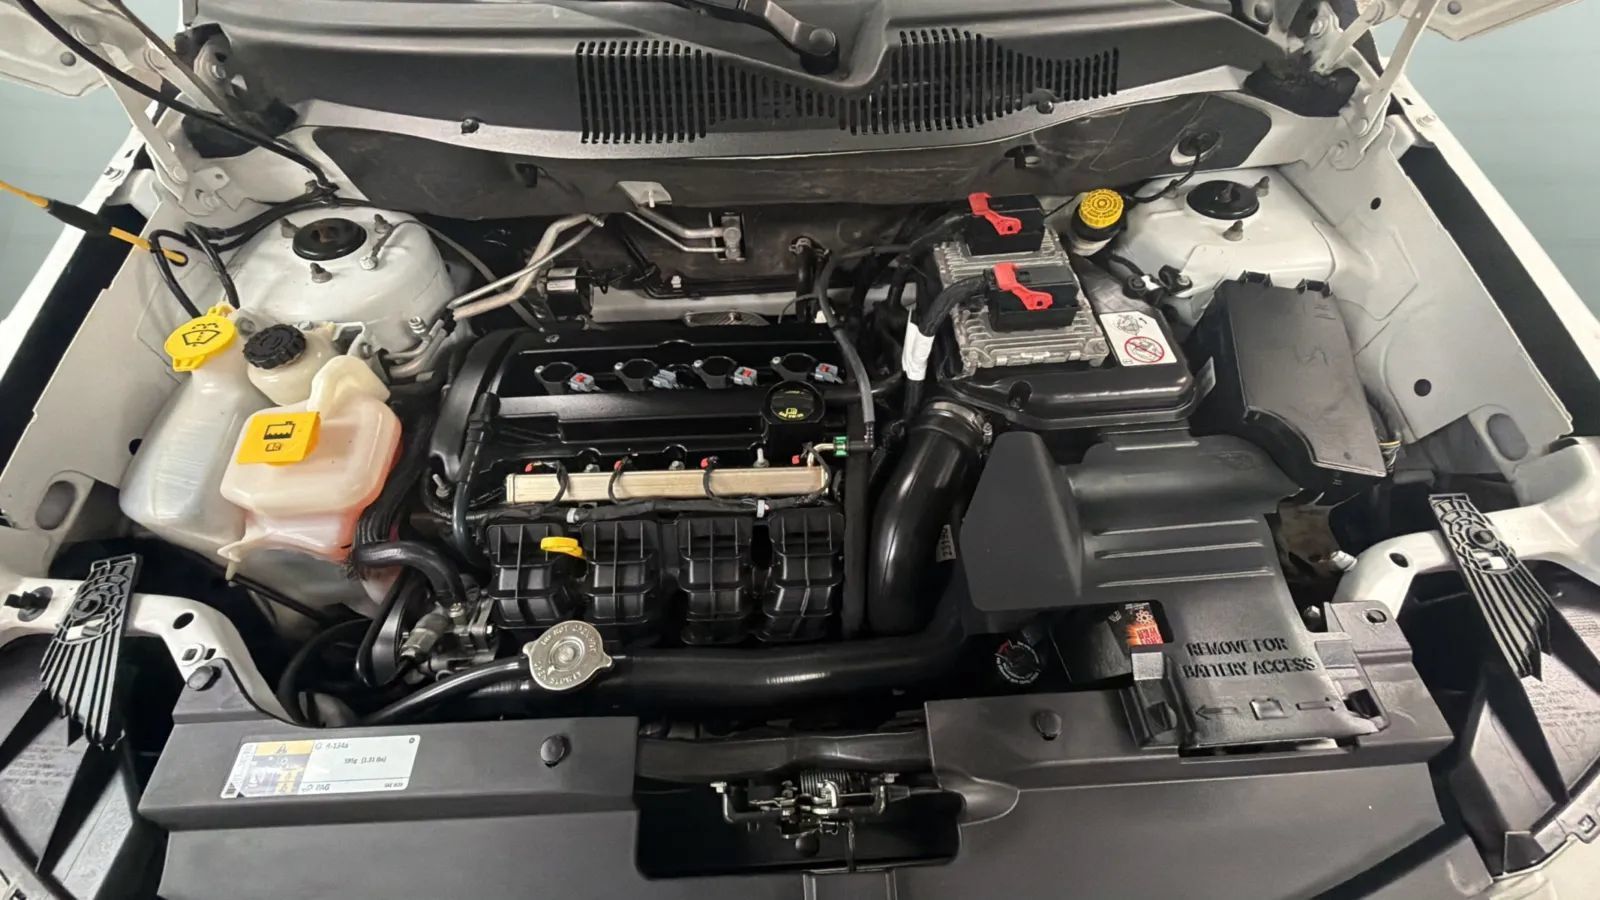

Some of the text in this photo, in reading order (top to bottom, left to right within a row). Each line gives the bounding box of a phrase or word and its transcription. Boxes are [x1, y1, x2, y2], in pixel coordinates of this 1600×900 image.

[1185, 637, 1289, 657] REMOVE FOR
[1182, 657, 1316, 679] BATTERY ACCESS
